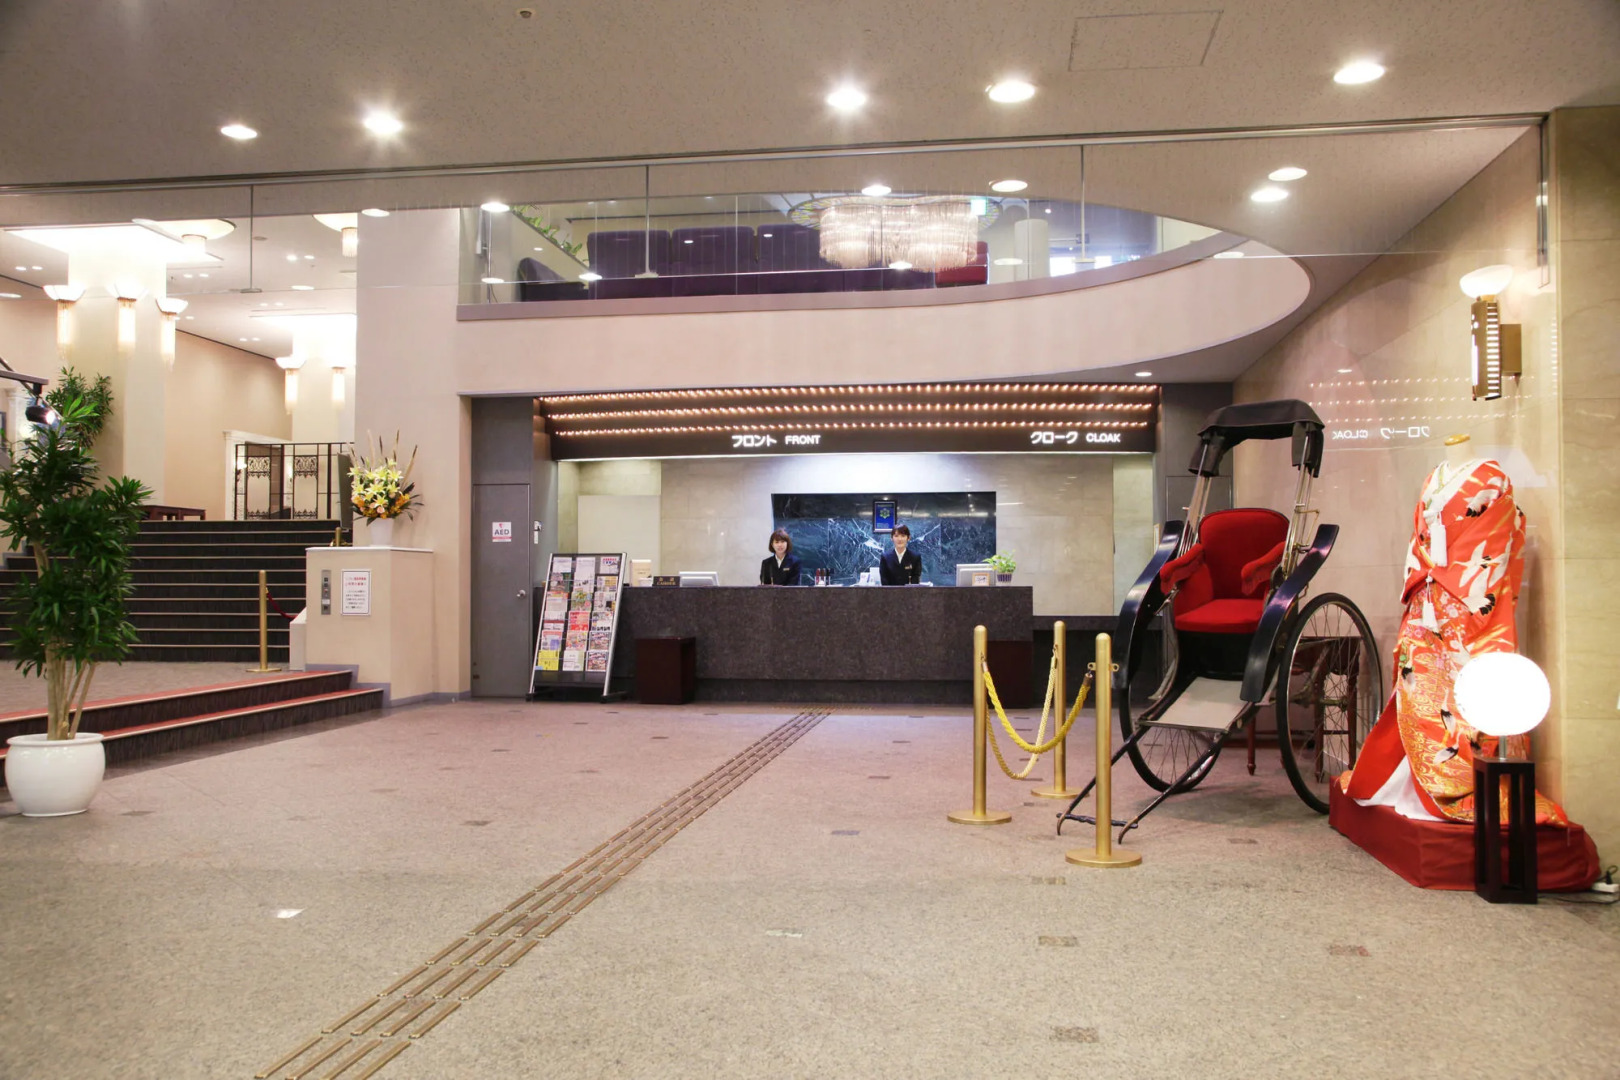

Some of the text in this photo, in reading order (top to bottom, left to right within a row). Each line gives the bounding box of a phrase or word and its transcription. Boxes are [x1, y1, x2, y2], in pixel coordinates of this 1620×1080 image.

[731, 434, 821, 448] フロント FRONT
[1030, 431, 1121, 444] クローク CLOAK
